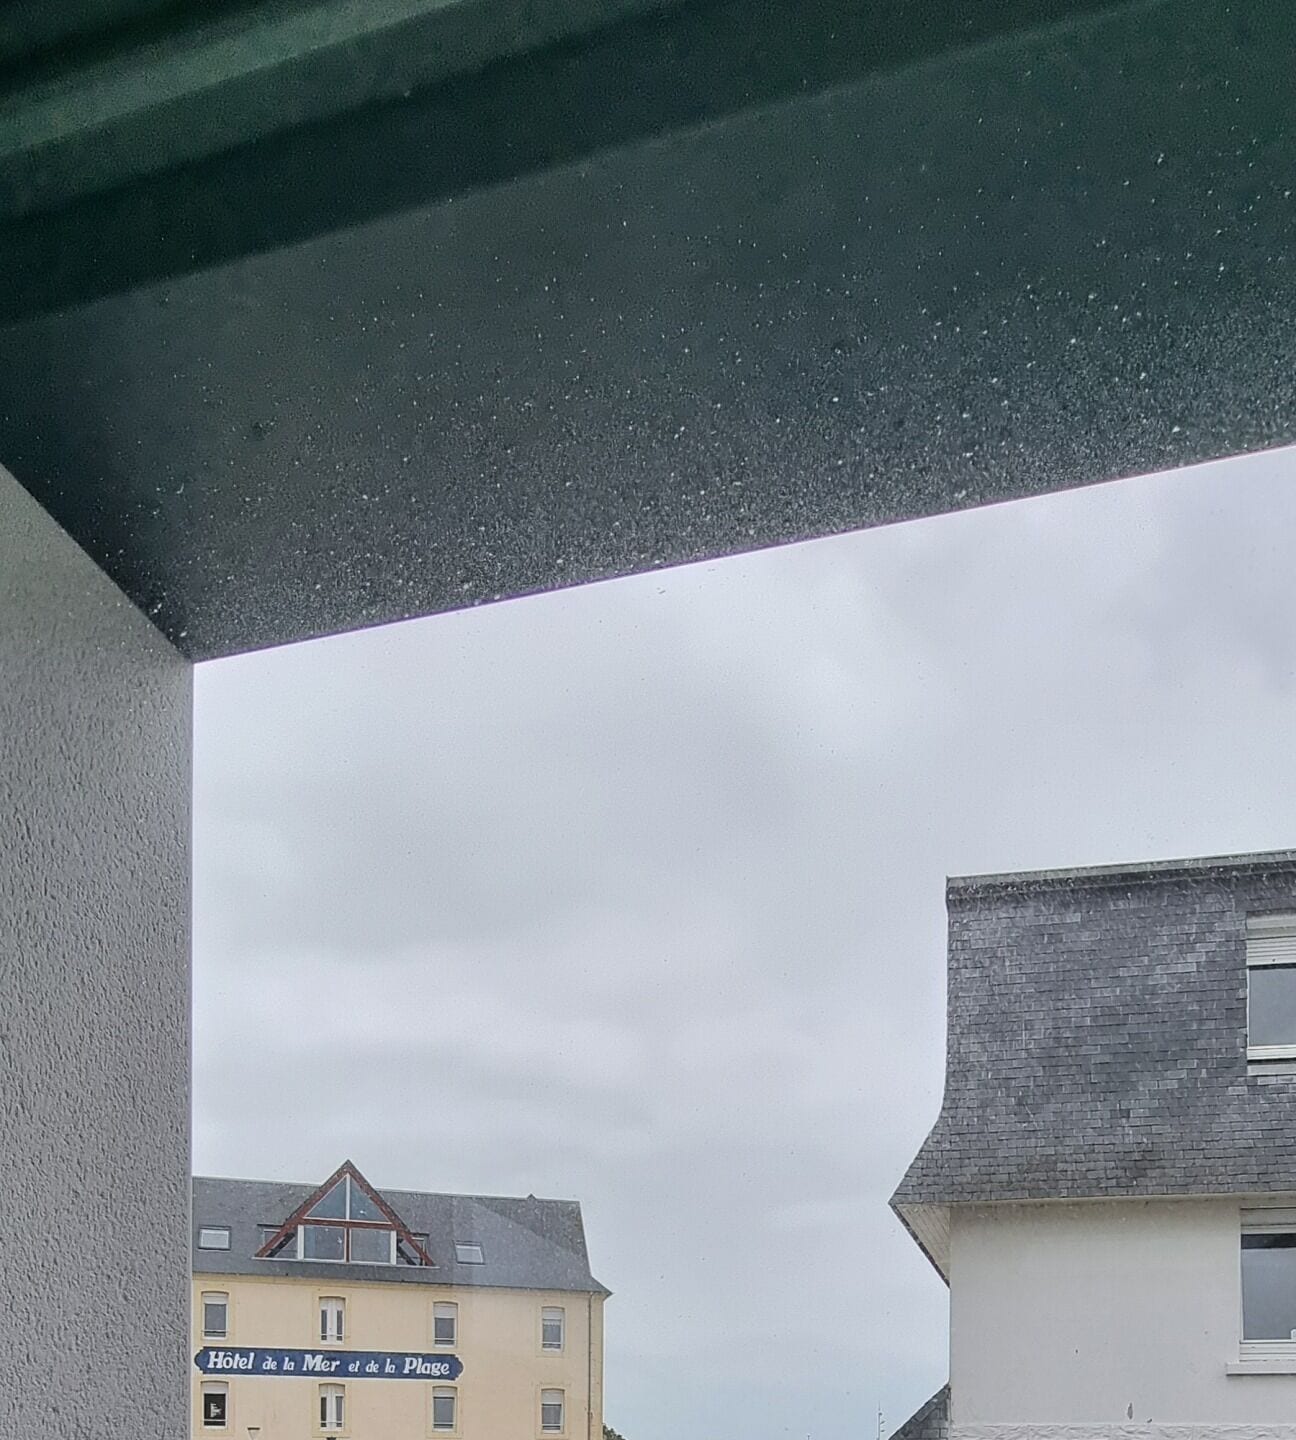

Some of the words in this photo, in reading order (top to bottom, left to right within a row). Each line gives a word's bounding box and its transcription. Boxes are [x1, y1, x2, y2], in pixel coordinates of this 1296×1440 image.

[207, 1350, 255, 1370] Hôtel
[262, 1355, 278, 1371] de
[283, 1356, 295, 1371] la
[302, 1353, 340, 1372] Mer
[348, 1360, 360, 1373] et
[365, 1358, 379, 1373] de
[384, 1358, 396, 1374] la
[403, 1357, 450, 1376] Plage
